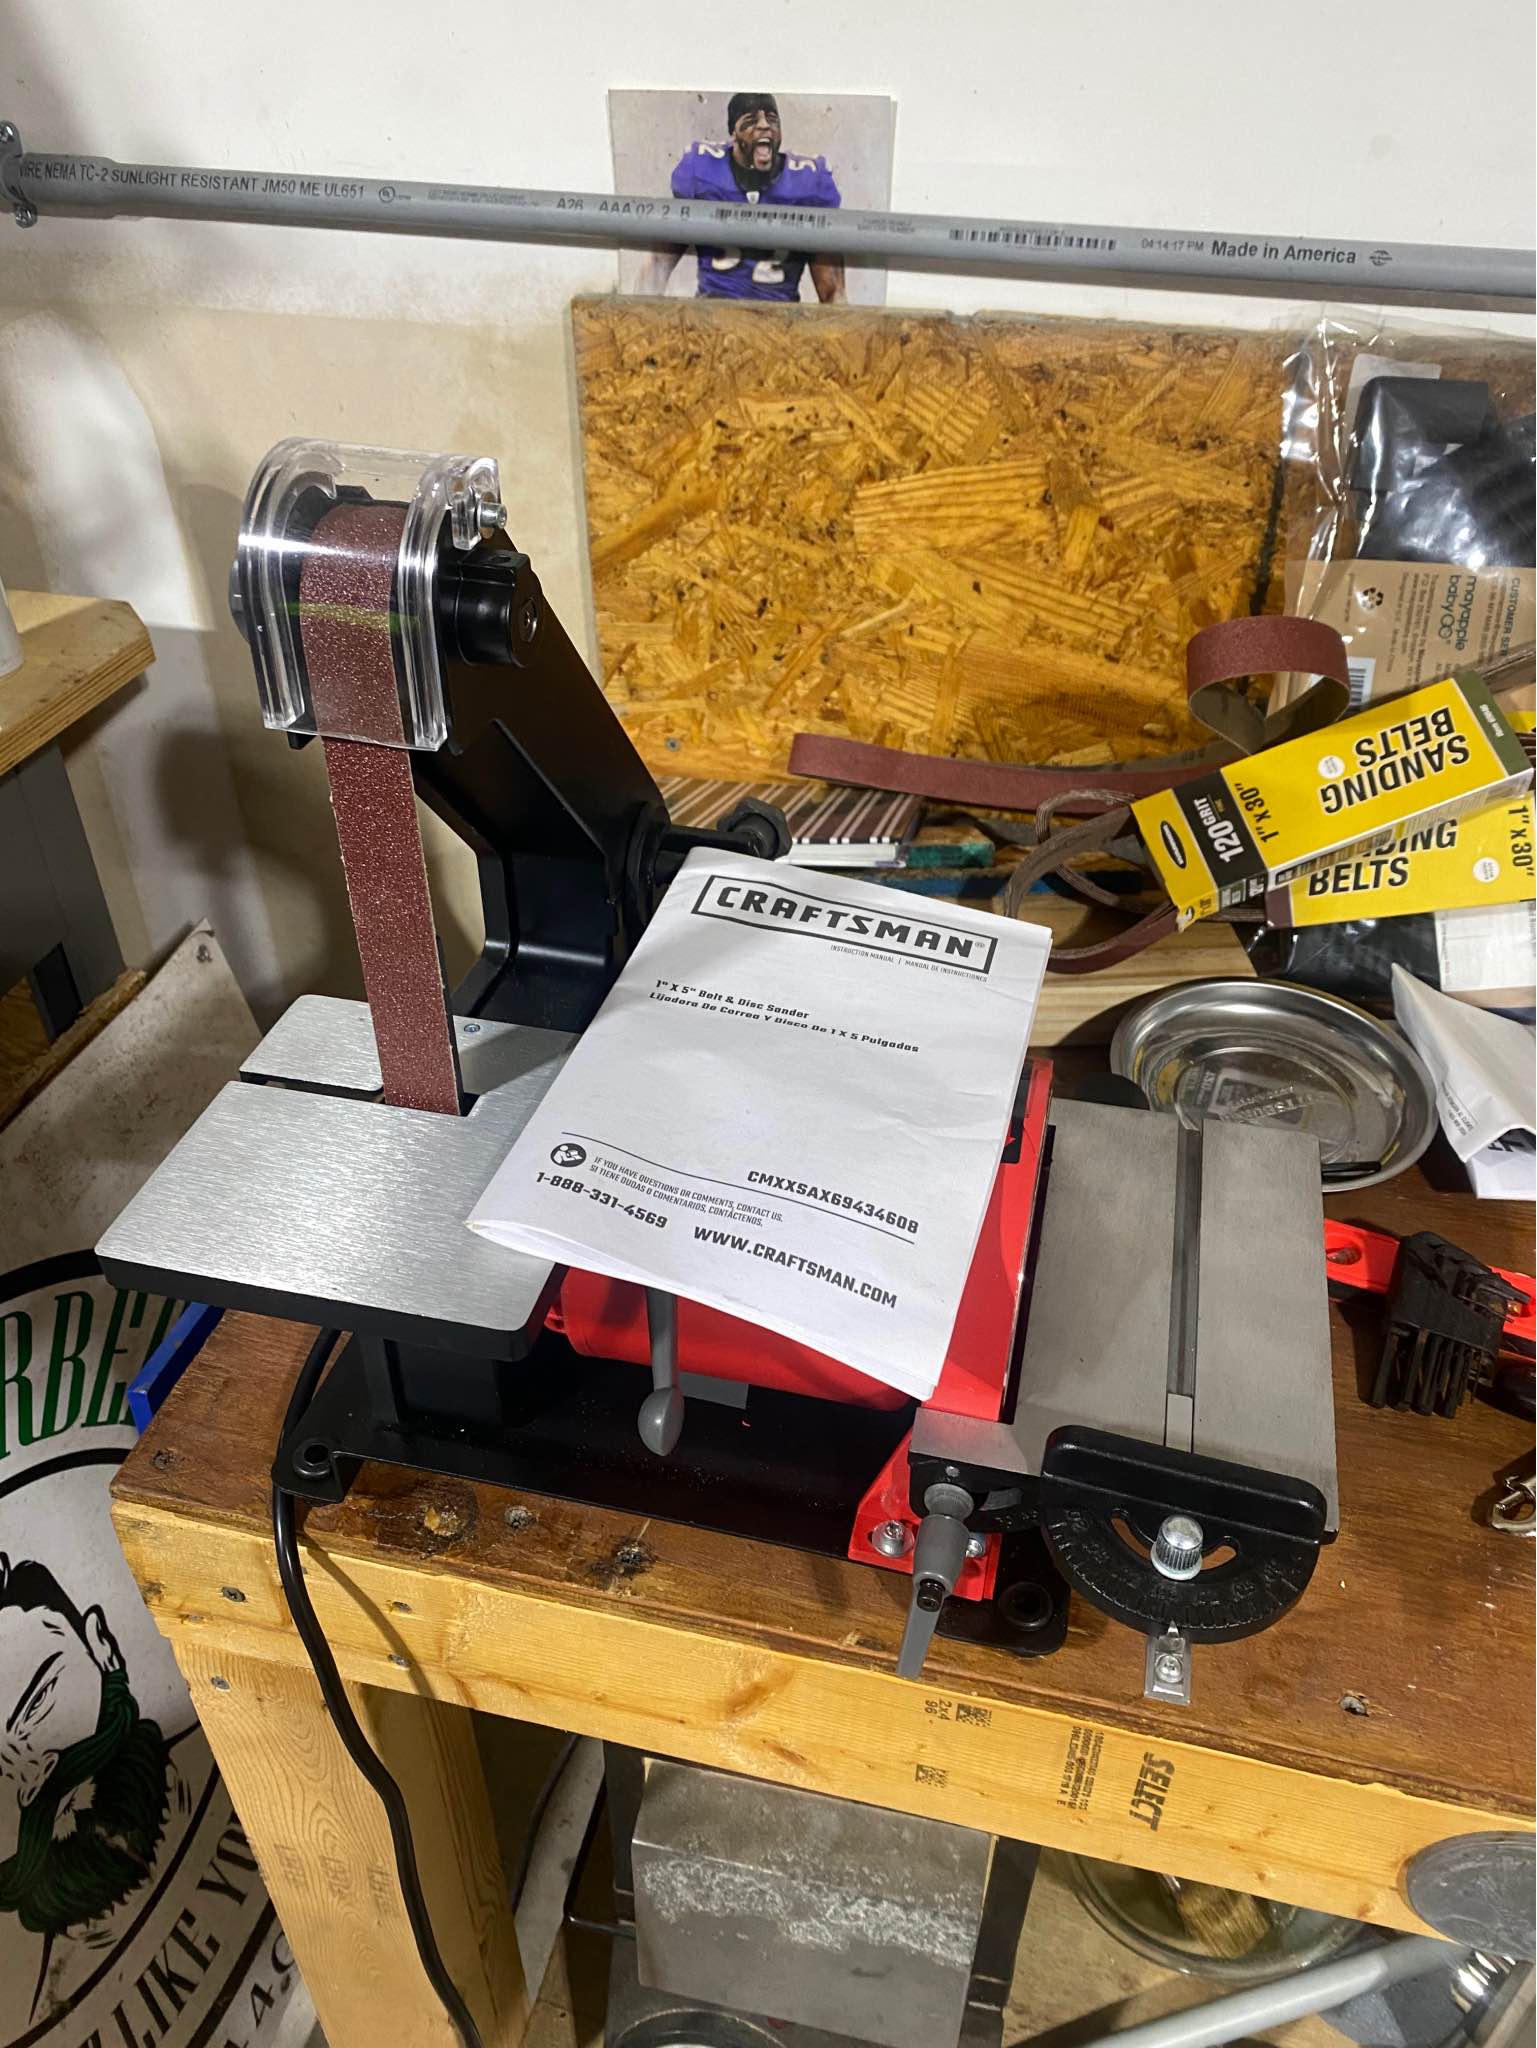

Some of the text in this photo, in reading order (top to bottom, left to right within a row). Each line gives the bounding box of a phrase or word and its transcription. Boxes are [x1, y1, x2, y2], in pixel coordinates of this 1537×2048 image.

[45, 162, 76, 180] NEMA
[80, 164, 109, 182] TC-2
[111, 169, 177, 188] SUNLIGHT
[181, 173, 258, 193] RESISTANT
[262, 179, 296, 194] JM50
[299, 181, 320, 197] ME
[324, 184, 364, 199] UL651
[1210, 239, 1356, 264] Made in America
[1456, 575, 1477, 651] mayapple
[1502, 577, 1520, 633] CUSTOMER
[1355, 707, 1455, 767] BELTS
[1320, 735, 1470, 814] SANDING
[1193, 797, 1217, 827] GRIT
[1207, 820, 1245, 863] 120
[1234, 783, 1279, 842] 1" x 30"
[1508, 805, 1535, 877] 1" x 30"
[1308, 856, 1409, 896] BELTS
[717, 886, 974, 958] CRAFTSMAN
[830, 944, 869, 958] INSTRUCTION
[869, 952, 894, 964] MANUAL
[905, 959, 929, 970] MANUAL
[649, 991, 699, 1008] Lijadora
[719, 1006, 760, 1020] Correa
[763, 1014, 773, 1022] Y
[774, 1017, 808, 1029] Disco
[838, 1030, 848, 1038] X
[850, 1032, 859, 1040] 5
[861, 1034, 920, 1053] Pulgadas
[669, 983, 679, 992] X
[698, 989, 723, 1001] Belt
[724, 995, 734, 1004] &
[737, 998, 764, 1010] Disc
[766, 1004, 810, 1019] Sander
[535, 1170, 668, 1229] 1-888-331-4569
[589, 1163, 599, 1173] SI
[599, 1168, 622, 1181] TIENE
[620, 1176, 648, 1193] DUDAS
[646, 1187, 653, 1196] O
[652, 1190, 707, 1214] COMENTARIOS,
[593, 1156, 783, 1222] IF YOU HAVE QUESTIONS OR COMMENTS, CONTACT US.
[746, 1170, 920, 1235] CMXXSAX69434608
[693, 1226, 898, 1309] WWW.CRAFTSMAN.COM
[1128, 1751, 1176, 1832] SELECT
[111, 1907, 221, 2048] LIKE
